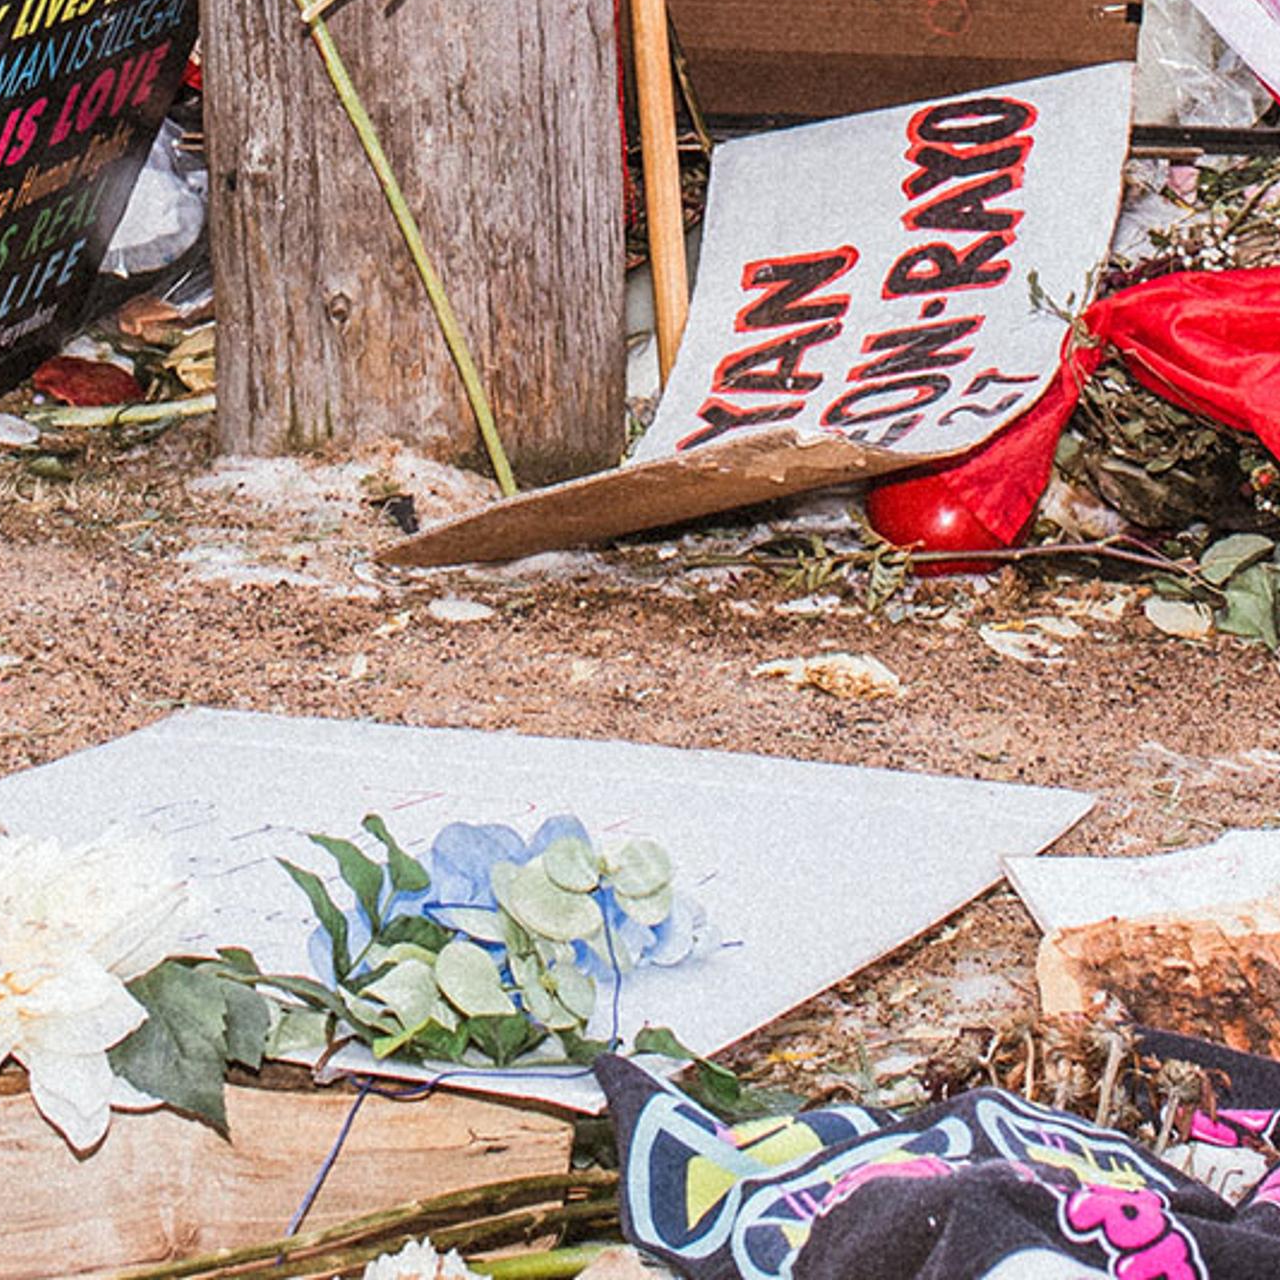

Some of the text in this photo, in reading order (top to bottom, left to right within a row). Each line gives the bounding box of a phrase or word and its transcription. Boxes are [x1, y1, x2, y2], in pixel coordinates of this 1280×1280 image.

[65, 20, 103, 74] IS
[49, 42, 169, 146] LOVE
[20, 176, 108, 261] REAL
[938, 367, 1040, 427] 27
